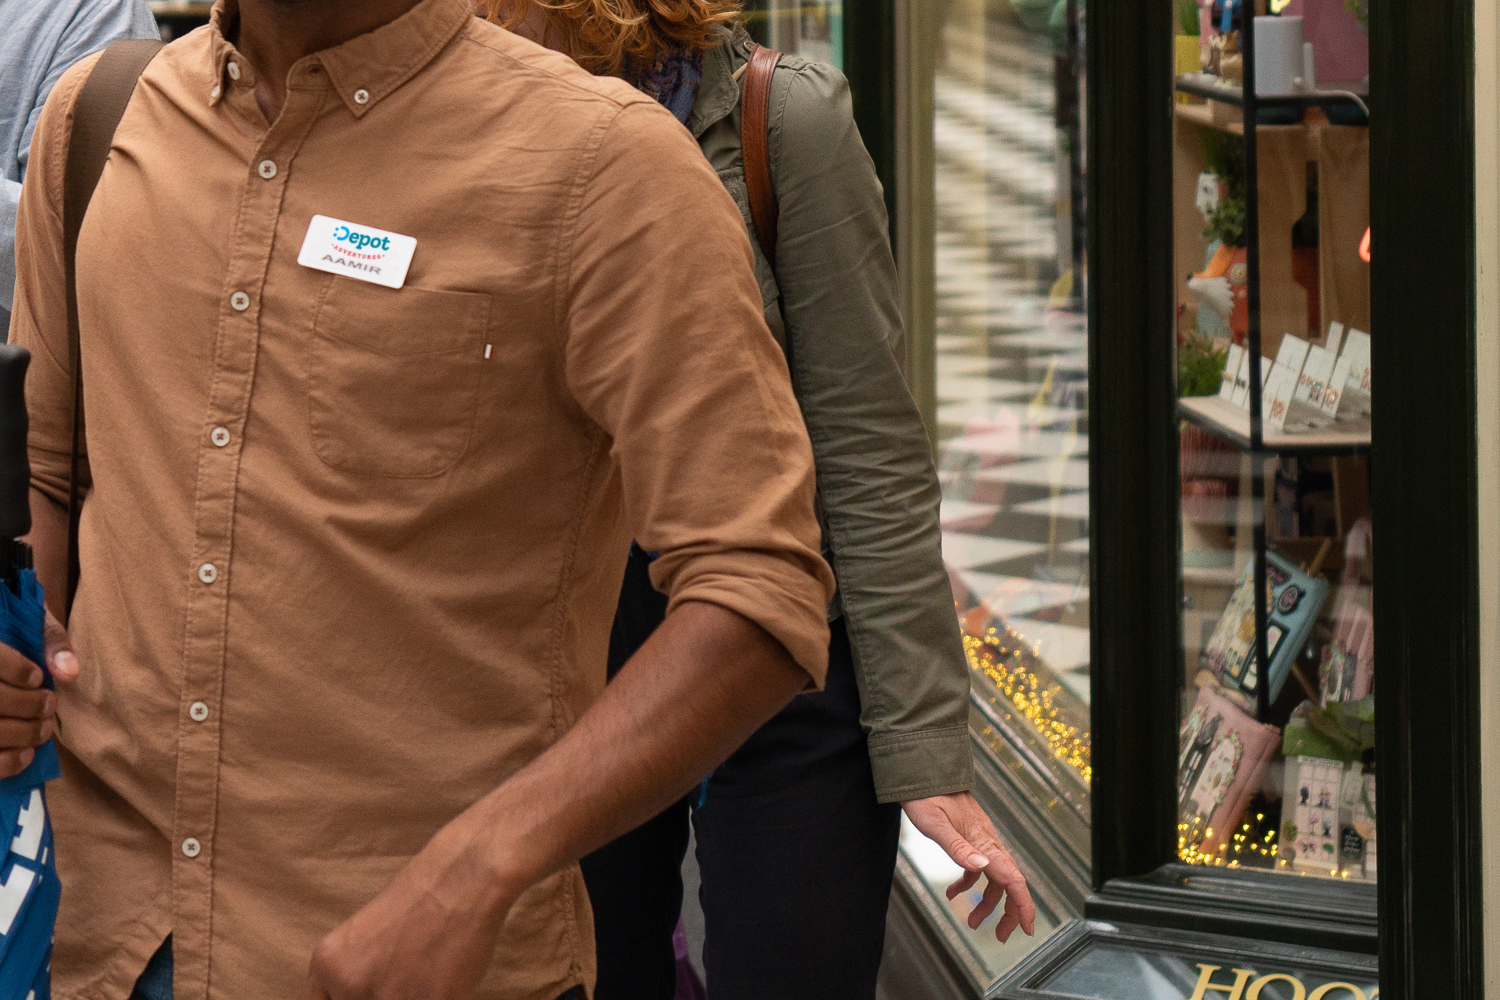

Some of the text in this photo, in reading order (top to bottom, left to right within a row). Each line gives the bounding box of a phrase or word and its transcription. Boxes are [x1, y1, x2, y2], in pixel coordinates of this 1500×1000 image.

[333, 225, 391, 251] Depot
[332, 244, 384, 260] ADVENTURES
[321, 254, 382, 275] AAMIR
